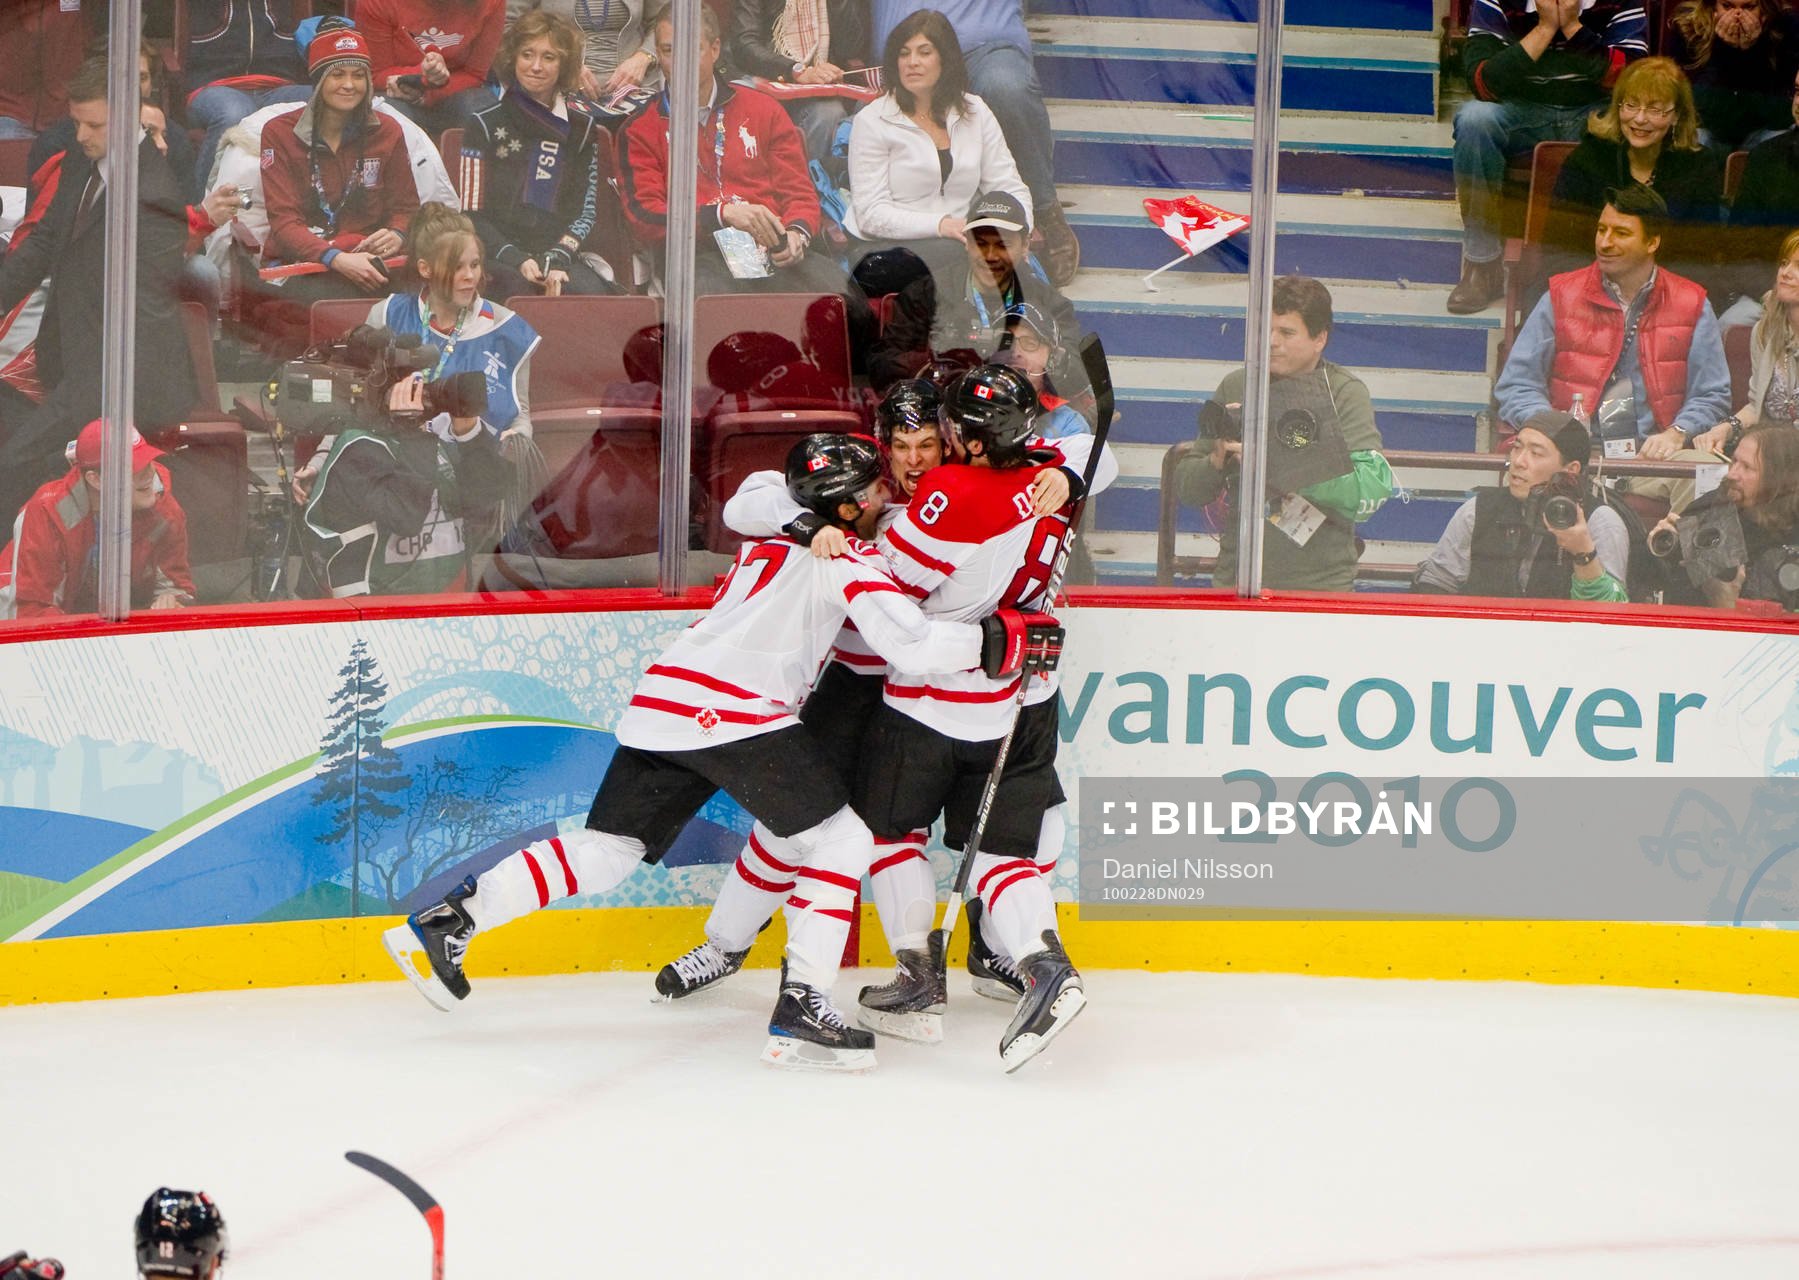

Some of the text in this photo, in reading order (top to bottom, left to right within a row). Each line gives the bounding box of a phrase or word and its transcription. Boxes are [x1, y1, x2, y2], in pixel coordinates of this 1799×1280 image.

[535, 140, 559, 181] USA
[918, 490, 950, 526] 8
[998, 514, 1068, 610] 8
[1058, 670, 1708, 764] vancouver
[975, 782, 996, 836] BAUER
[1216, 769, 1517, 853] 2010
